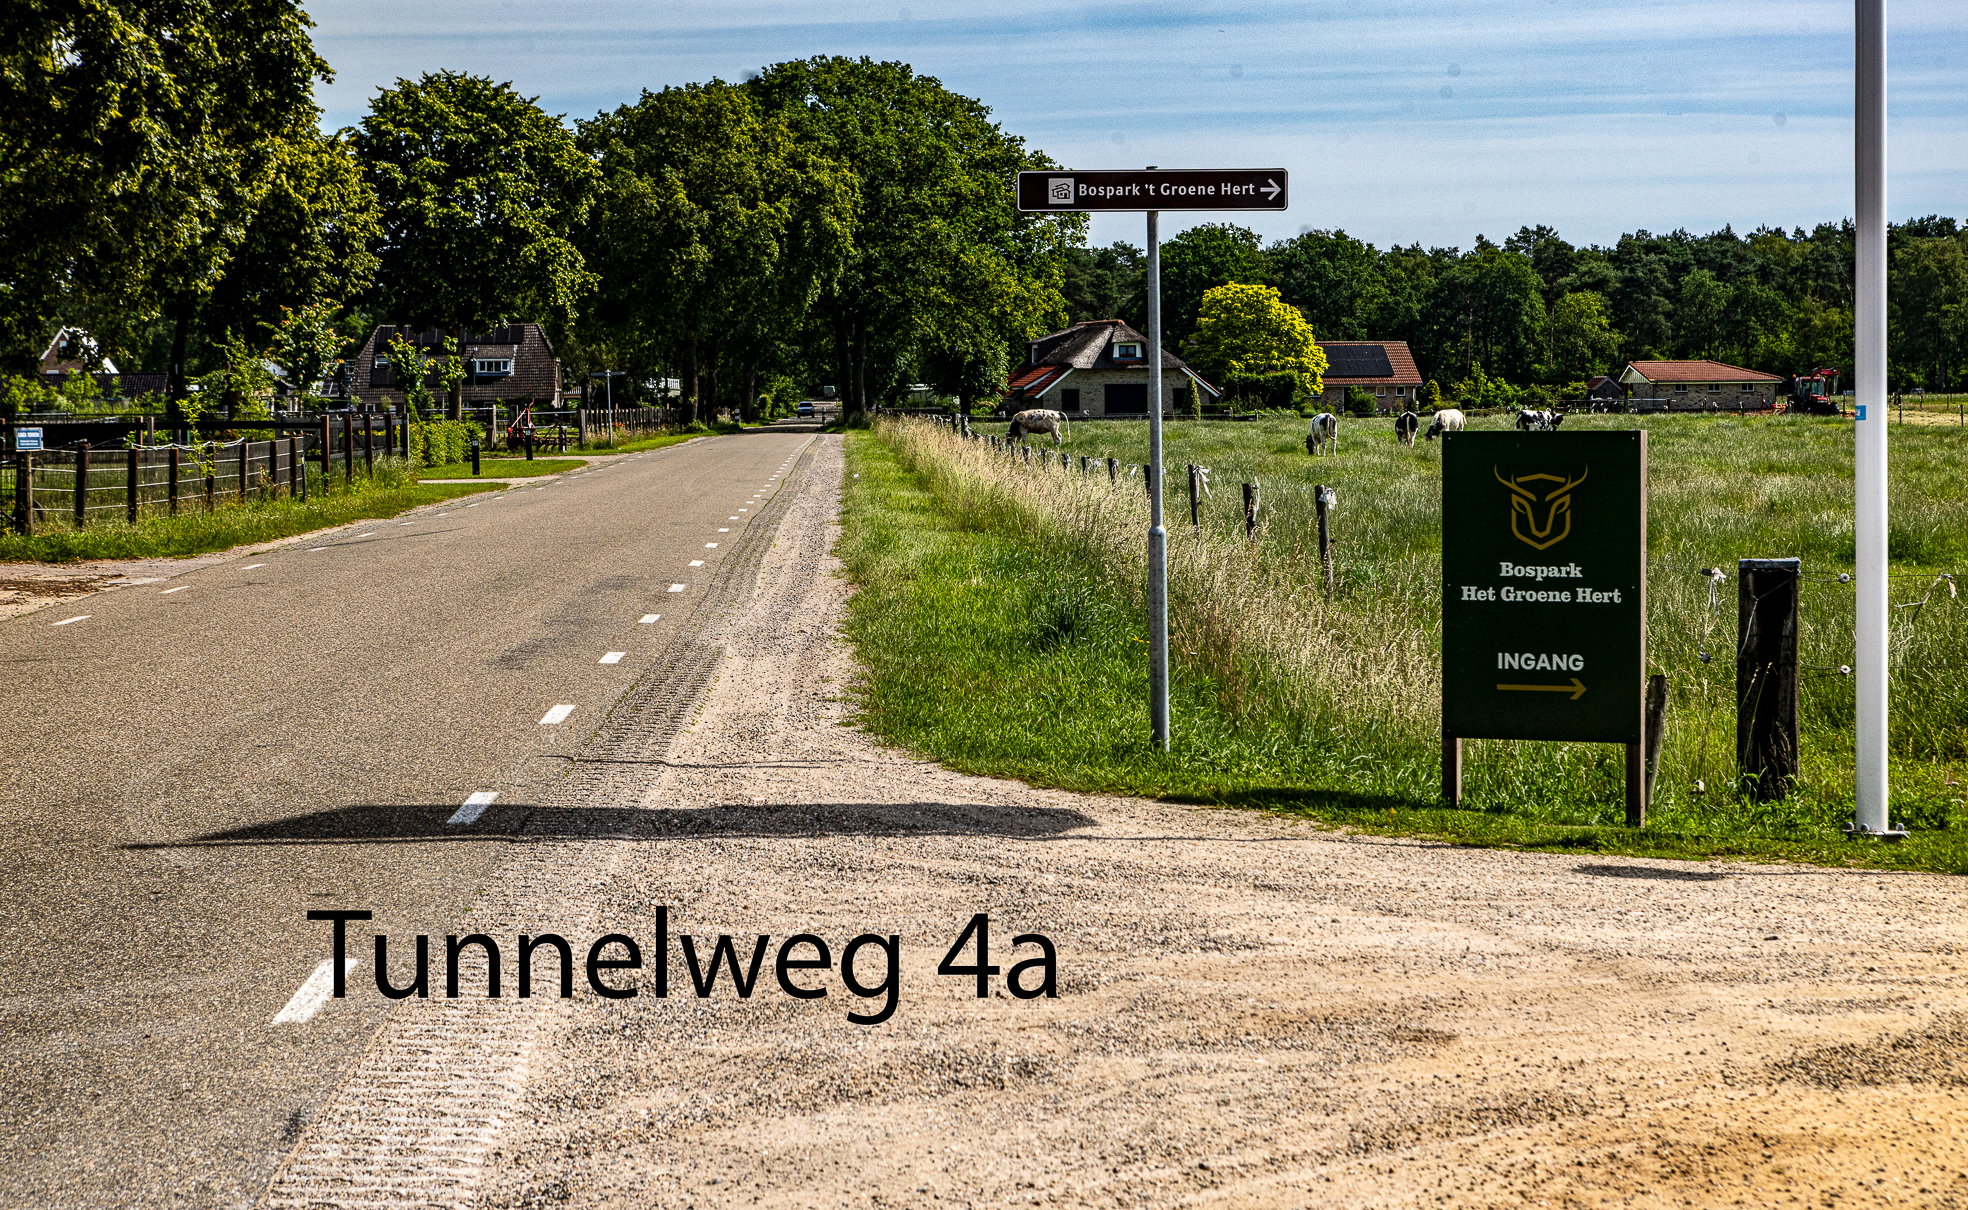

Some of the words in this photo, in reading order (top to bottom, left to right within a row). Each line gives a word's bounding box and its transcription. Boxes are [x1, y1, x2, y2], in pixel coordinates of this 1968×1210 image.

[1079, 183, 1140, 199] Bospark
[1145, 183, 1155, 195] 't
[1160, 184, 1215, 196] Groene
[1221, 182, 1255, 195] Hert
[1499, 561, 1583, 581] Bospark
[1461, 586, 1496, 602] Het
[1500, 586, 1571, 603] Groene
[1576, 587, 1622, 604] Hert
[1497, 652, 1584, 672] INGANG
